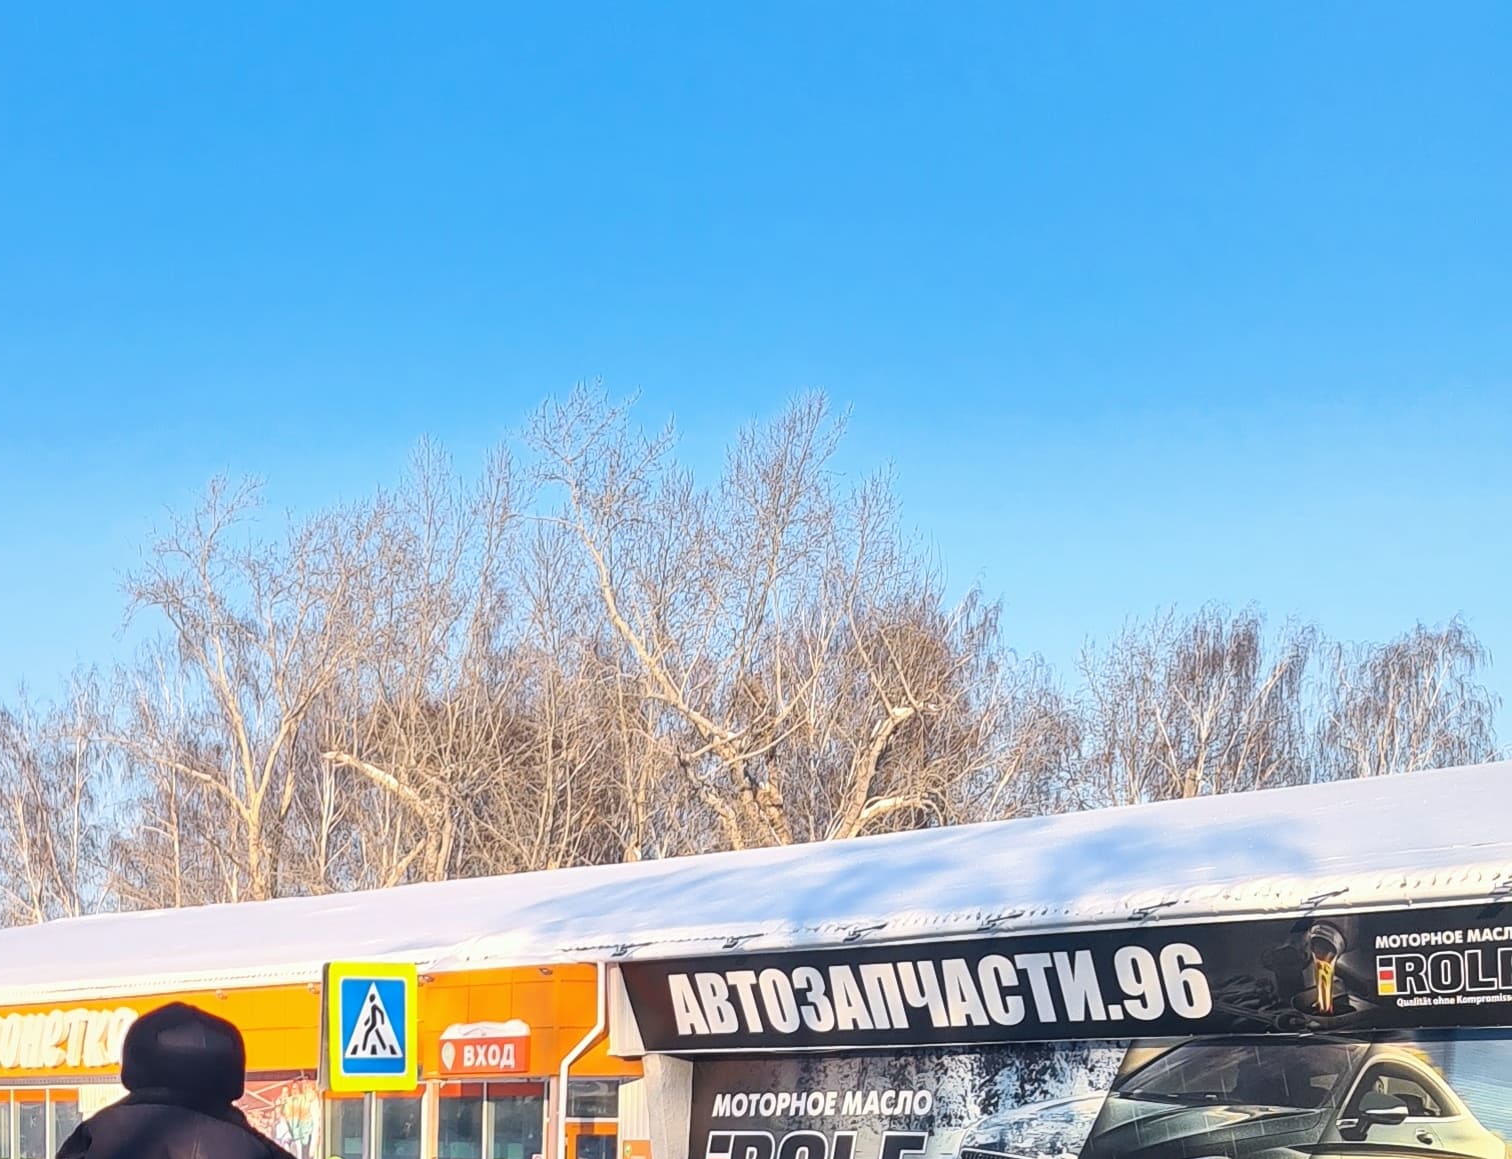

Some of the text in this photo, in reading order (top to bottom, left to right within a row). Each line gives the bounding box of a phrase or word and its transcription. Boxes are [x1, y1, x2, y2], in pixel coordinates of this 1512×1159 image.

[1375, 930, 1464, 949] МОТОРНОЕ
[667, 942, 1214, 1036] АВТОЗАПЧАСТИ.96
[1433, 995, 1456, 1006] ohne
[463, 1043, 515, 1070] ВХОД
[712, 1090, 933, 1118] МОТОРНОЕ МАСЛО
